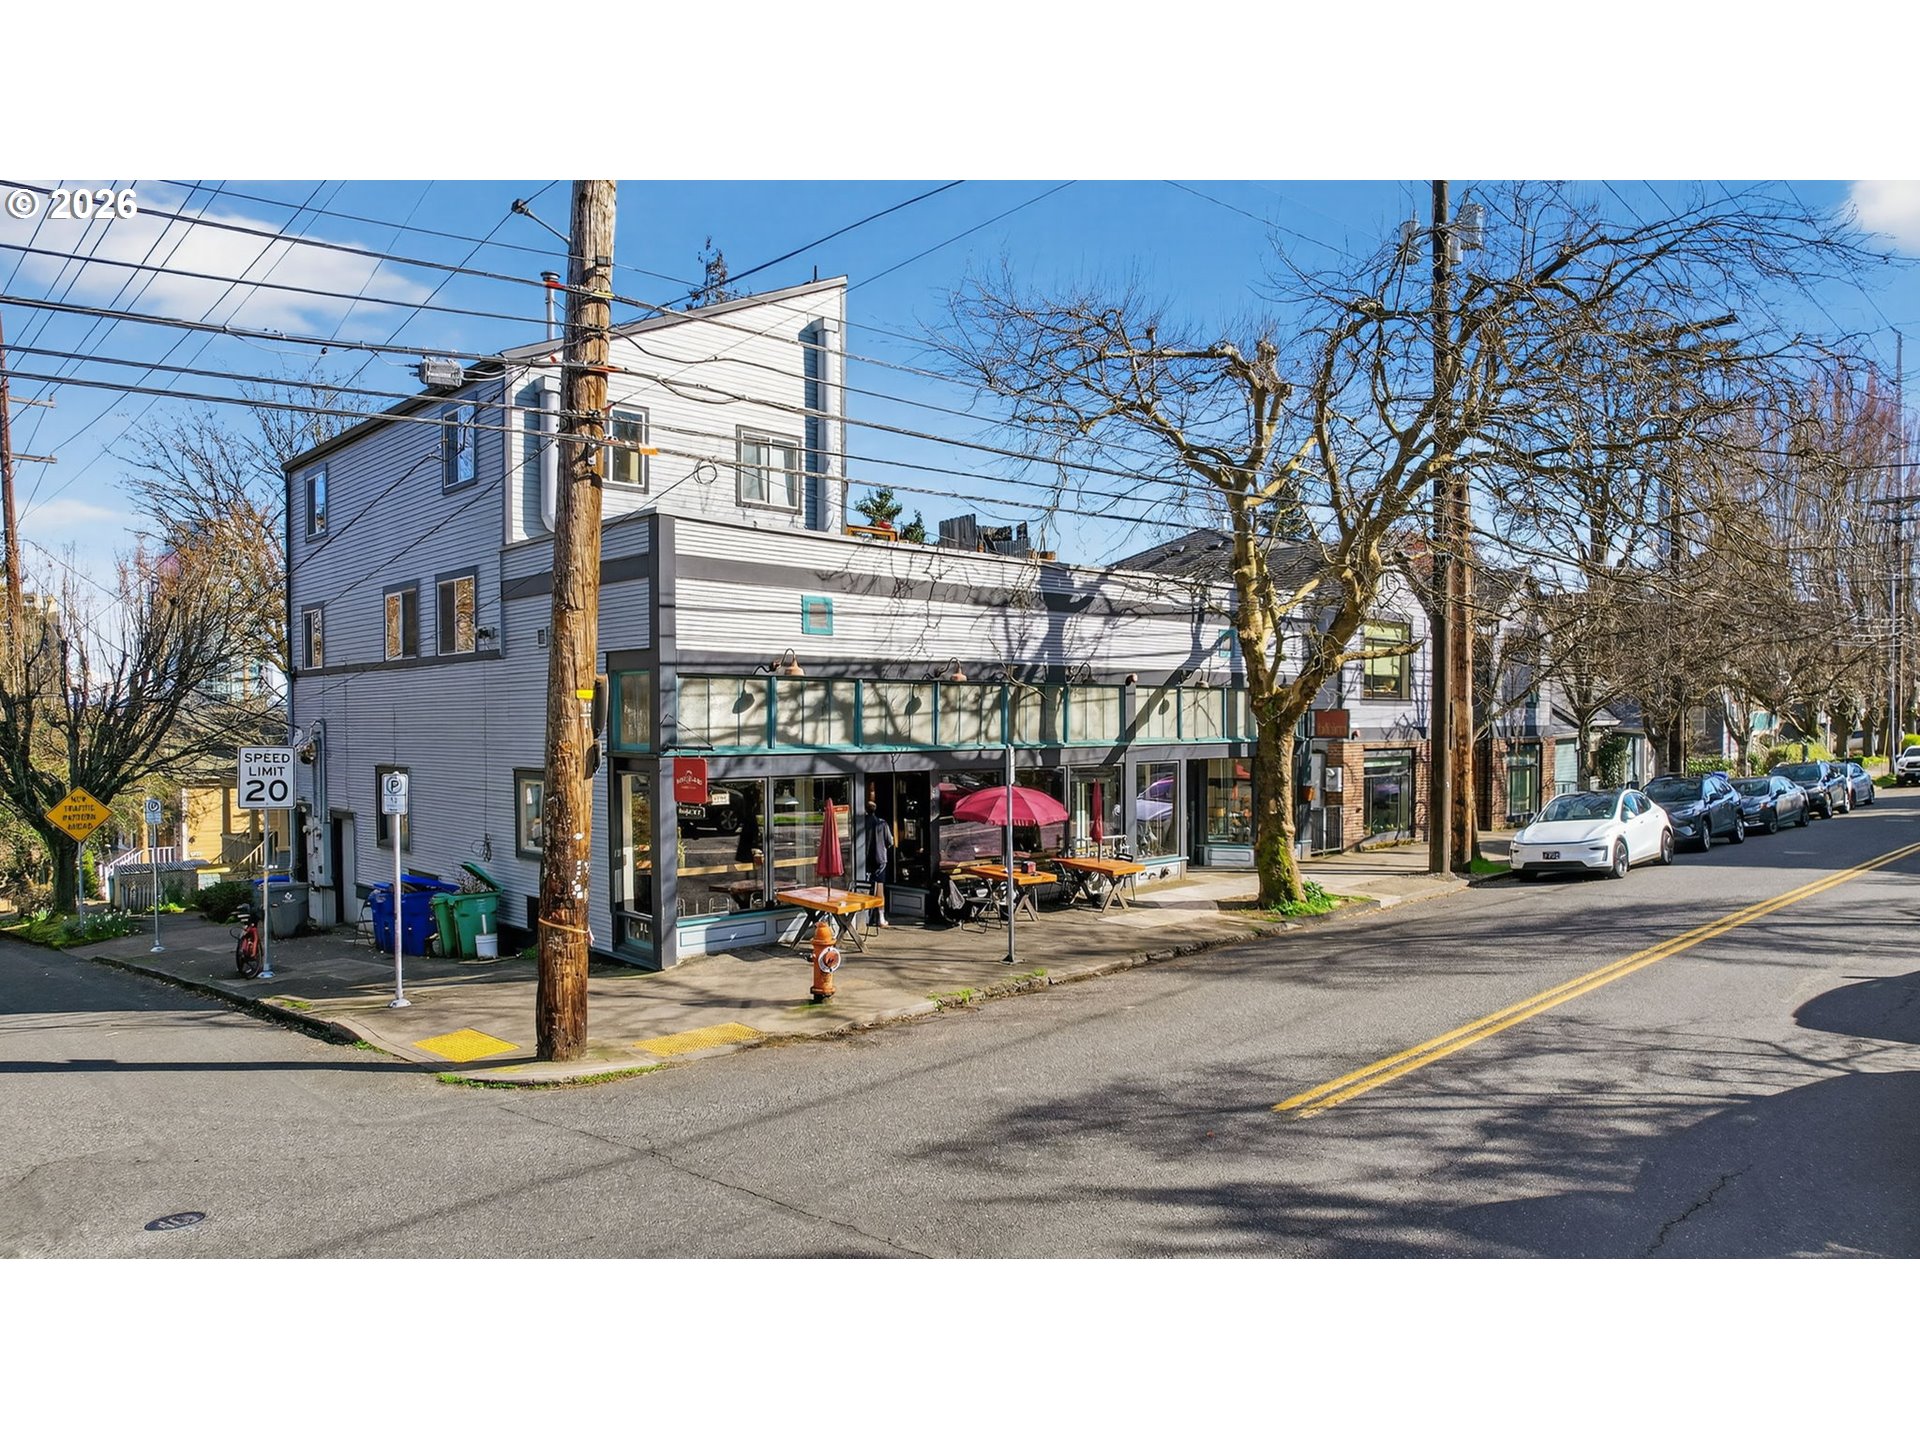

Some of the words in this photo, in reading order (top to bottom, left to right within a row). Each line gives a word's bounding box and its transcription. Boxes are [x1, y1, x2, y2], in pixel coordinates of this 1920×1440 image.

[244, 753, 290, 763] SPEED
[249, 766, 285, 777] LIMIT
[245, 779, 288, 802] 20
